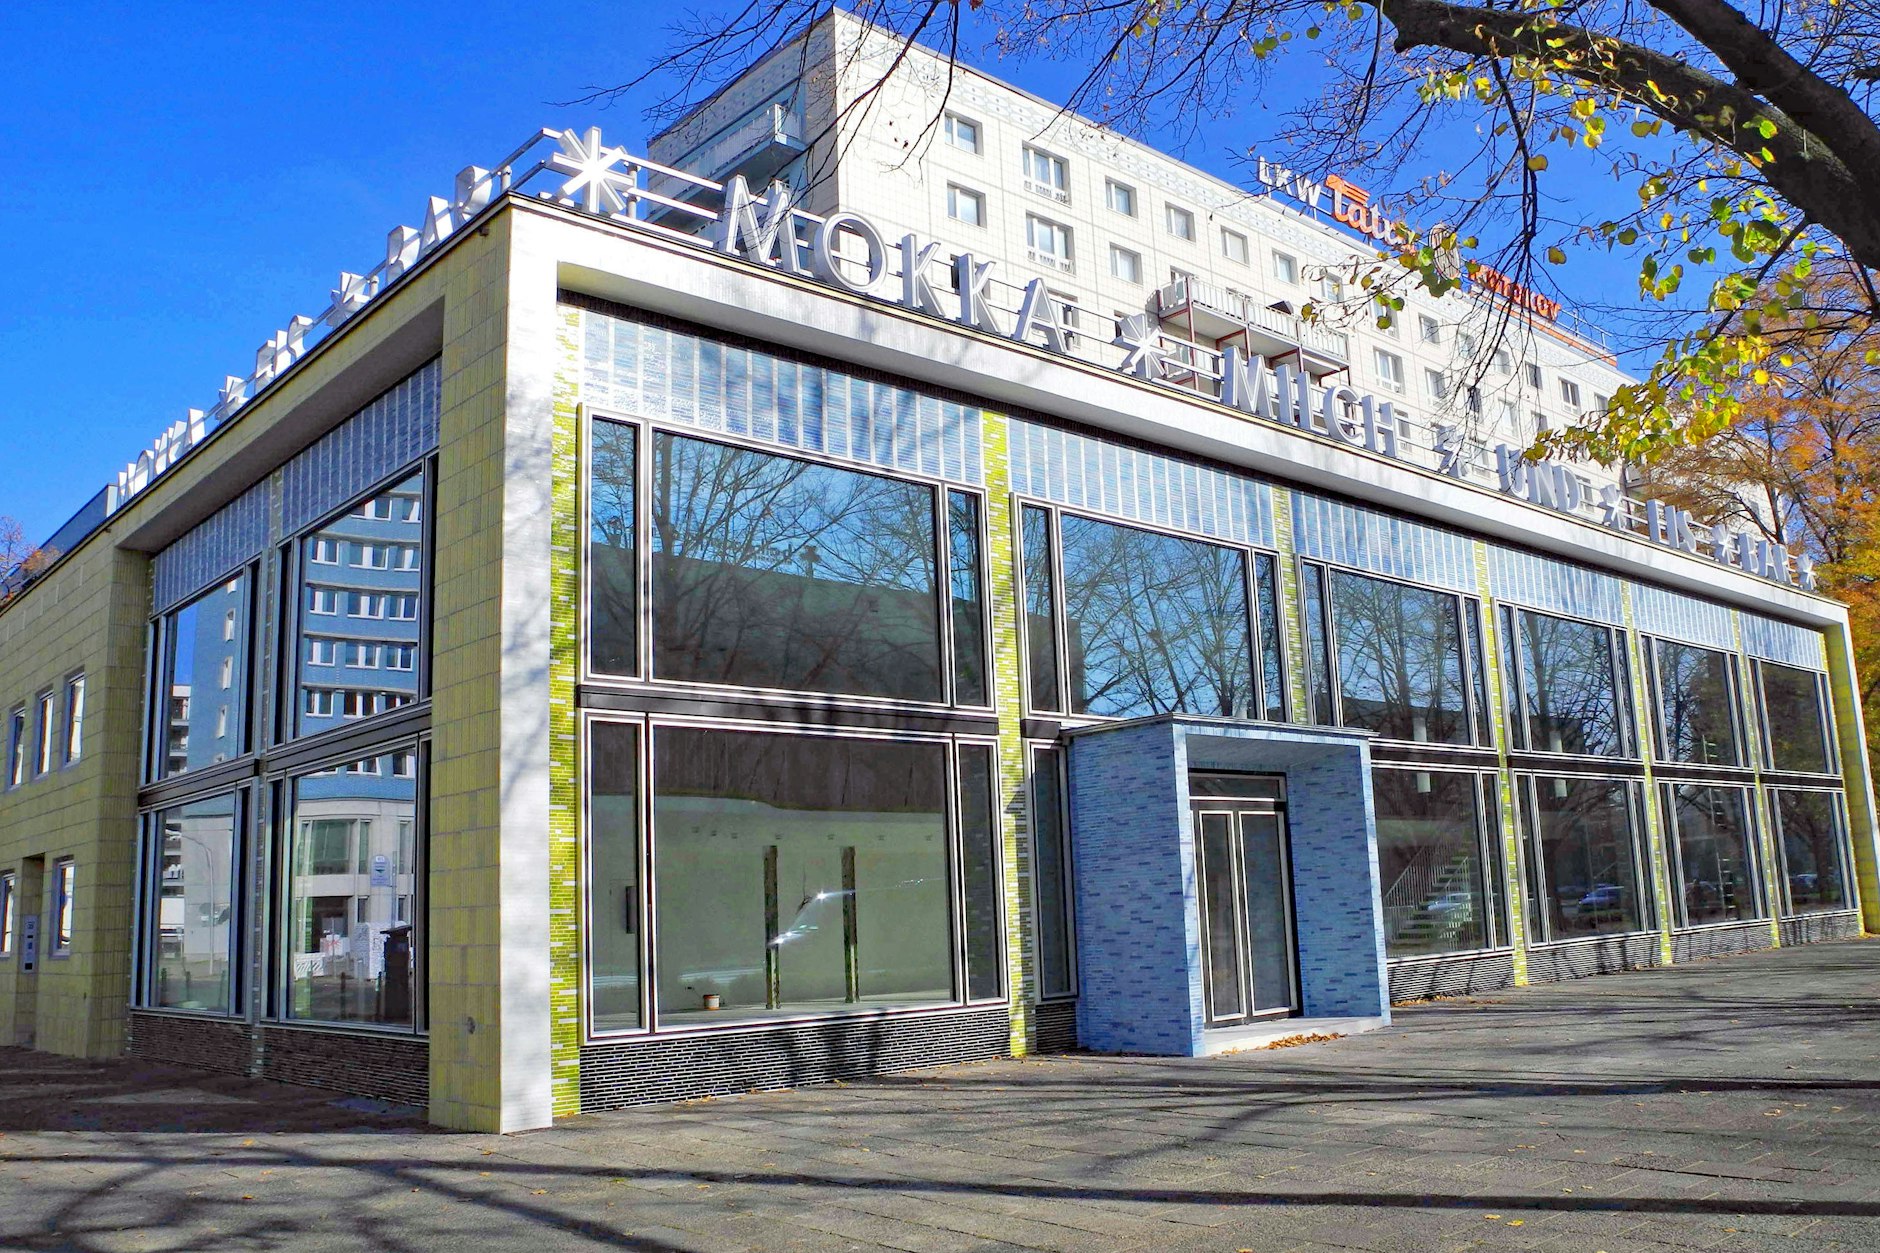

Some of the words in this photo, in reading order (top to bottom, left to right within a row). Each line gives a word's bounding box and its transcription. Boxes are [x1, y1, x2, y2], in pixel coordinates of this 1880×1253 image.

[386, 165, 493, 287] BAR
[718, 173, 1068, 354] MOKKA
[1221, 345, 1399, 459] MILCH
[1495, 443, 1580, 514] UND
[1646, 499, 1697, 553] EIS
[1738, 531, 1793, 586] BAR
